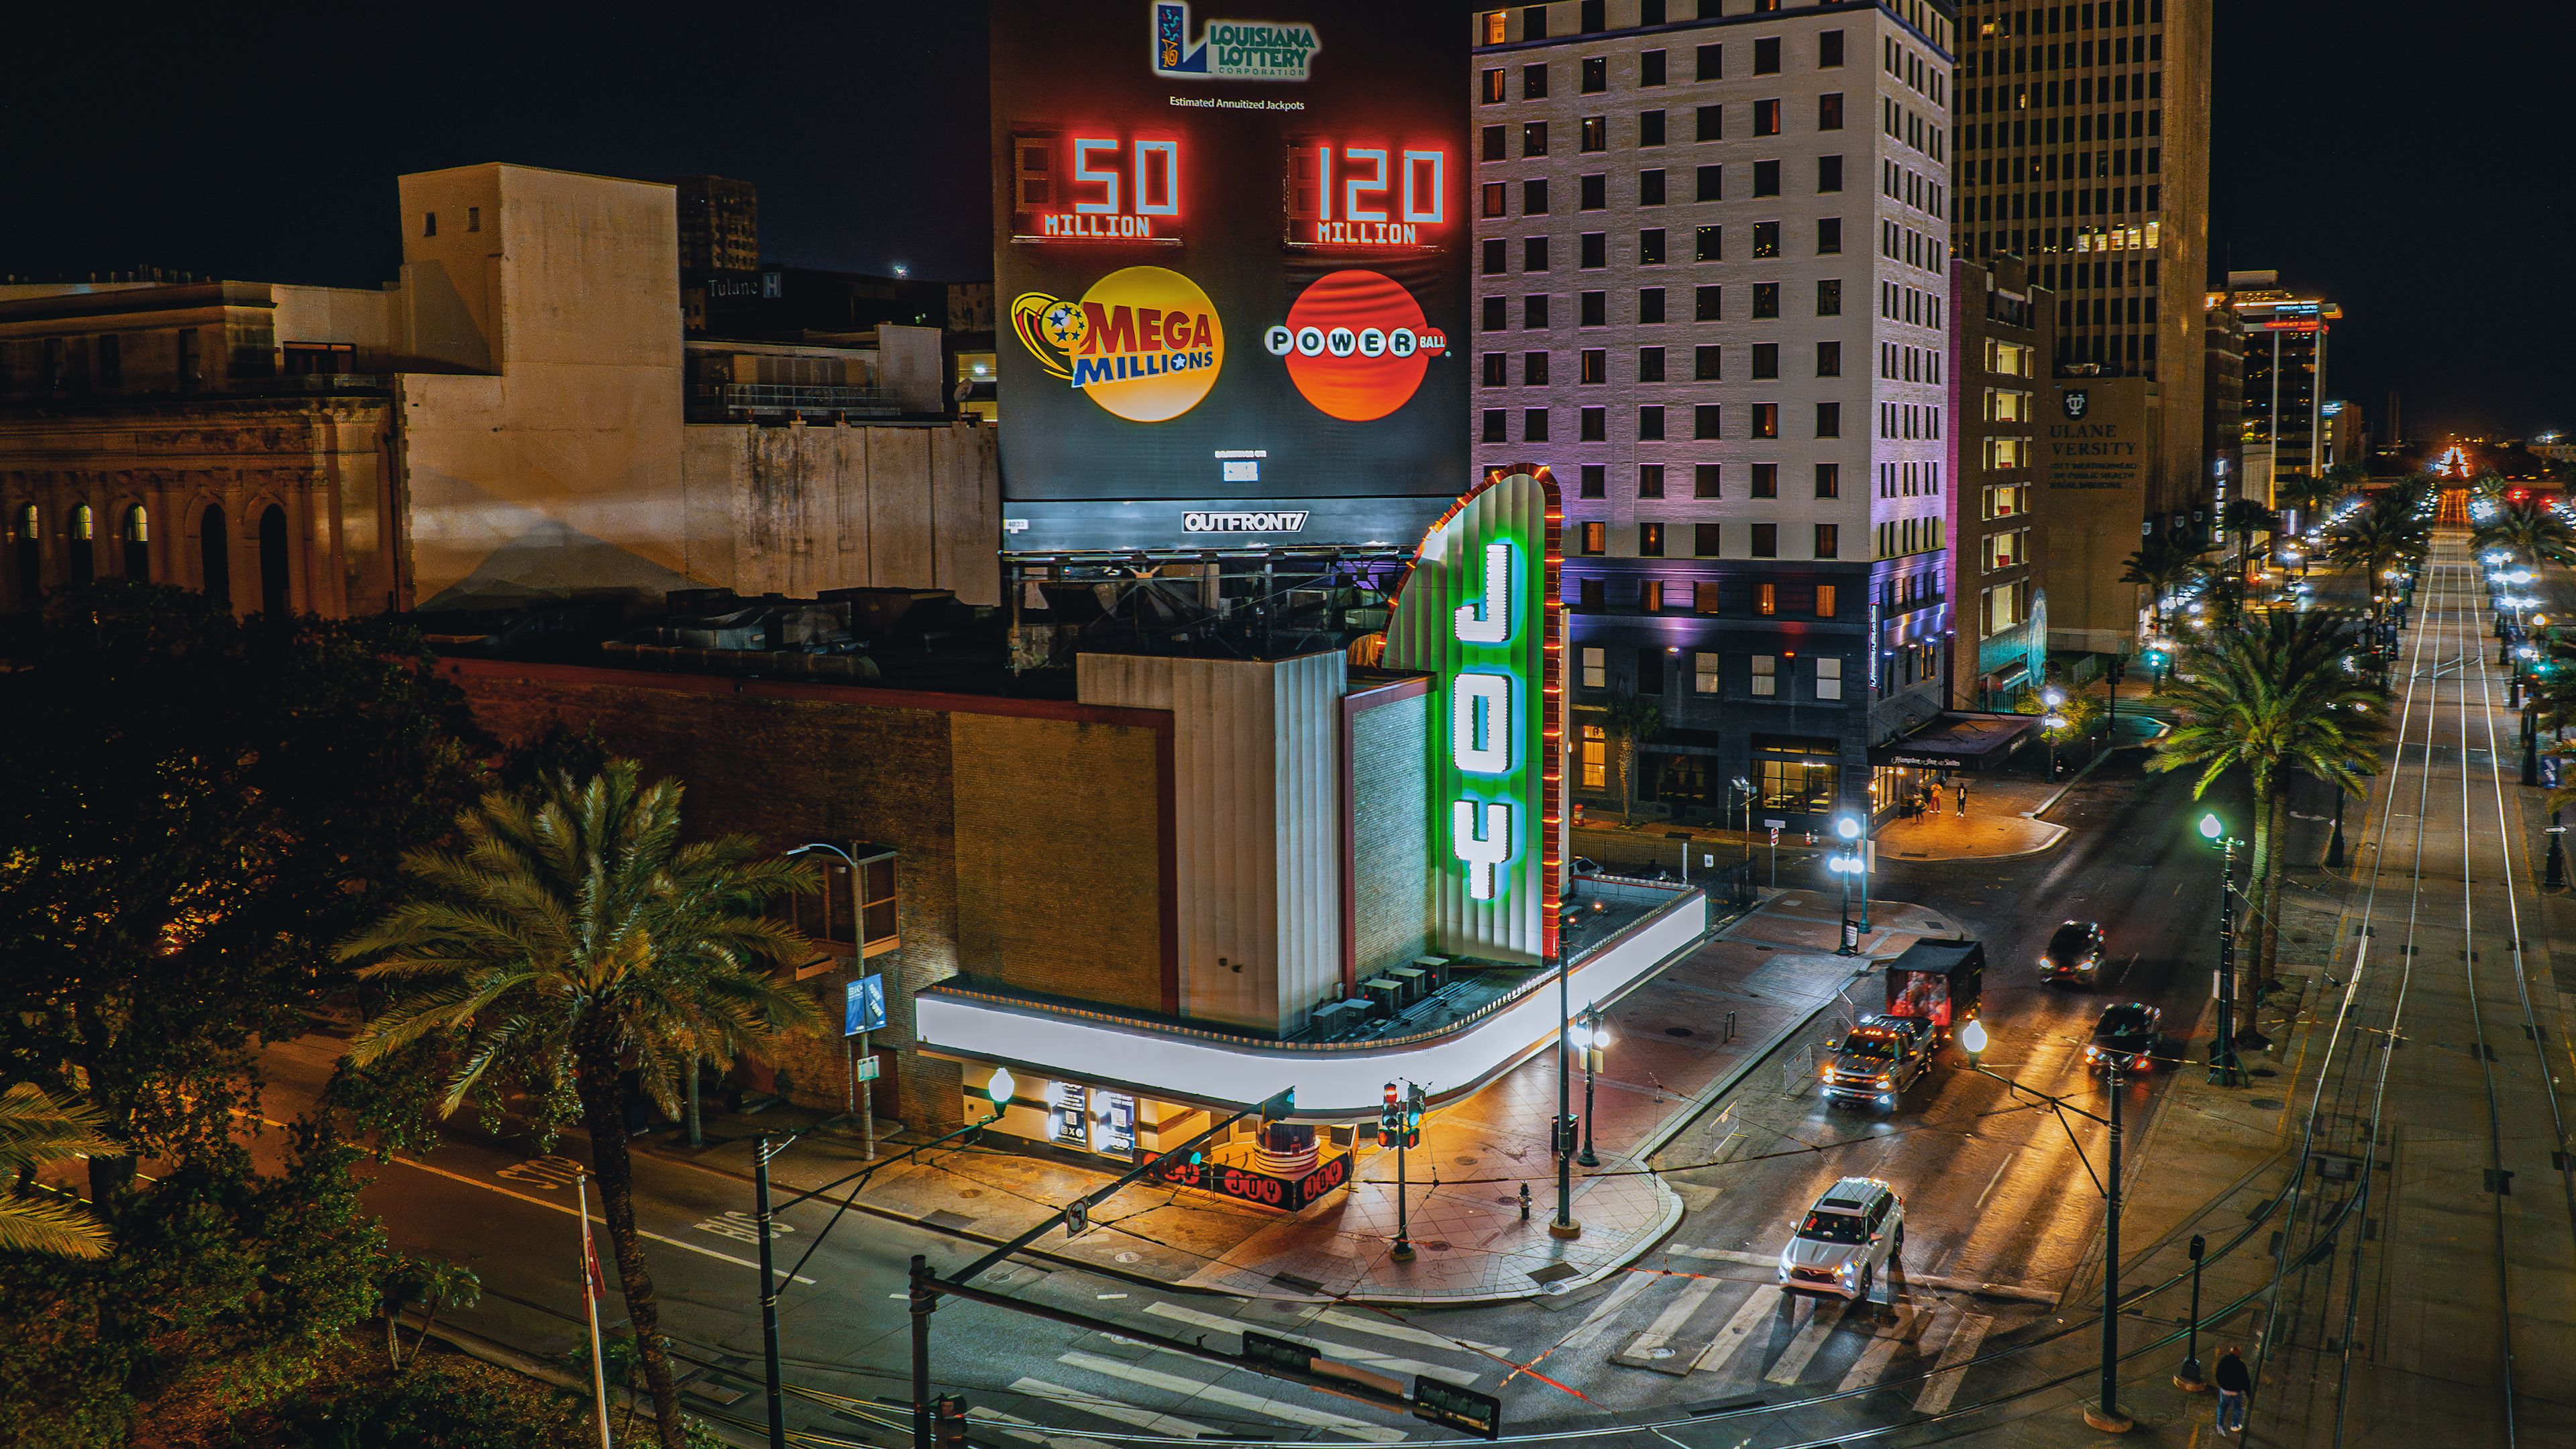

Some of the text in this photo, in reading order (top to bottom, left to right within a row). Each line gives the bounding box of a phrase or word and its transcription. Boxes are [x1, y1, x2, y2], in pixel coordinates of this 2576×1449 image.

[1210, 25, 1316, 48] LOUISIANA
[1219, 46, 1308, 68] LOTTERY
[1218, 66, 1305, 76] CORPORATION
[1170, 96, 1305, 111] Estimated Annuitized Jackpots
[1075, 138, 1178, 215] 50
[1320, 147, 1444, 223] 120
[1044, 214, 1150, 237] MILLION
[1317, 221, 1415, 244] MILLION
[708, 278, 758, 297] Tulane
[1079, 301, 1213, 355] MEGA
[1272, 330, 1411, 353] POWER
[1073, 351, 1214, 387] MILLIONS
[1454, 543, 1512, 900] JOY
